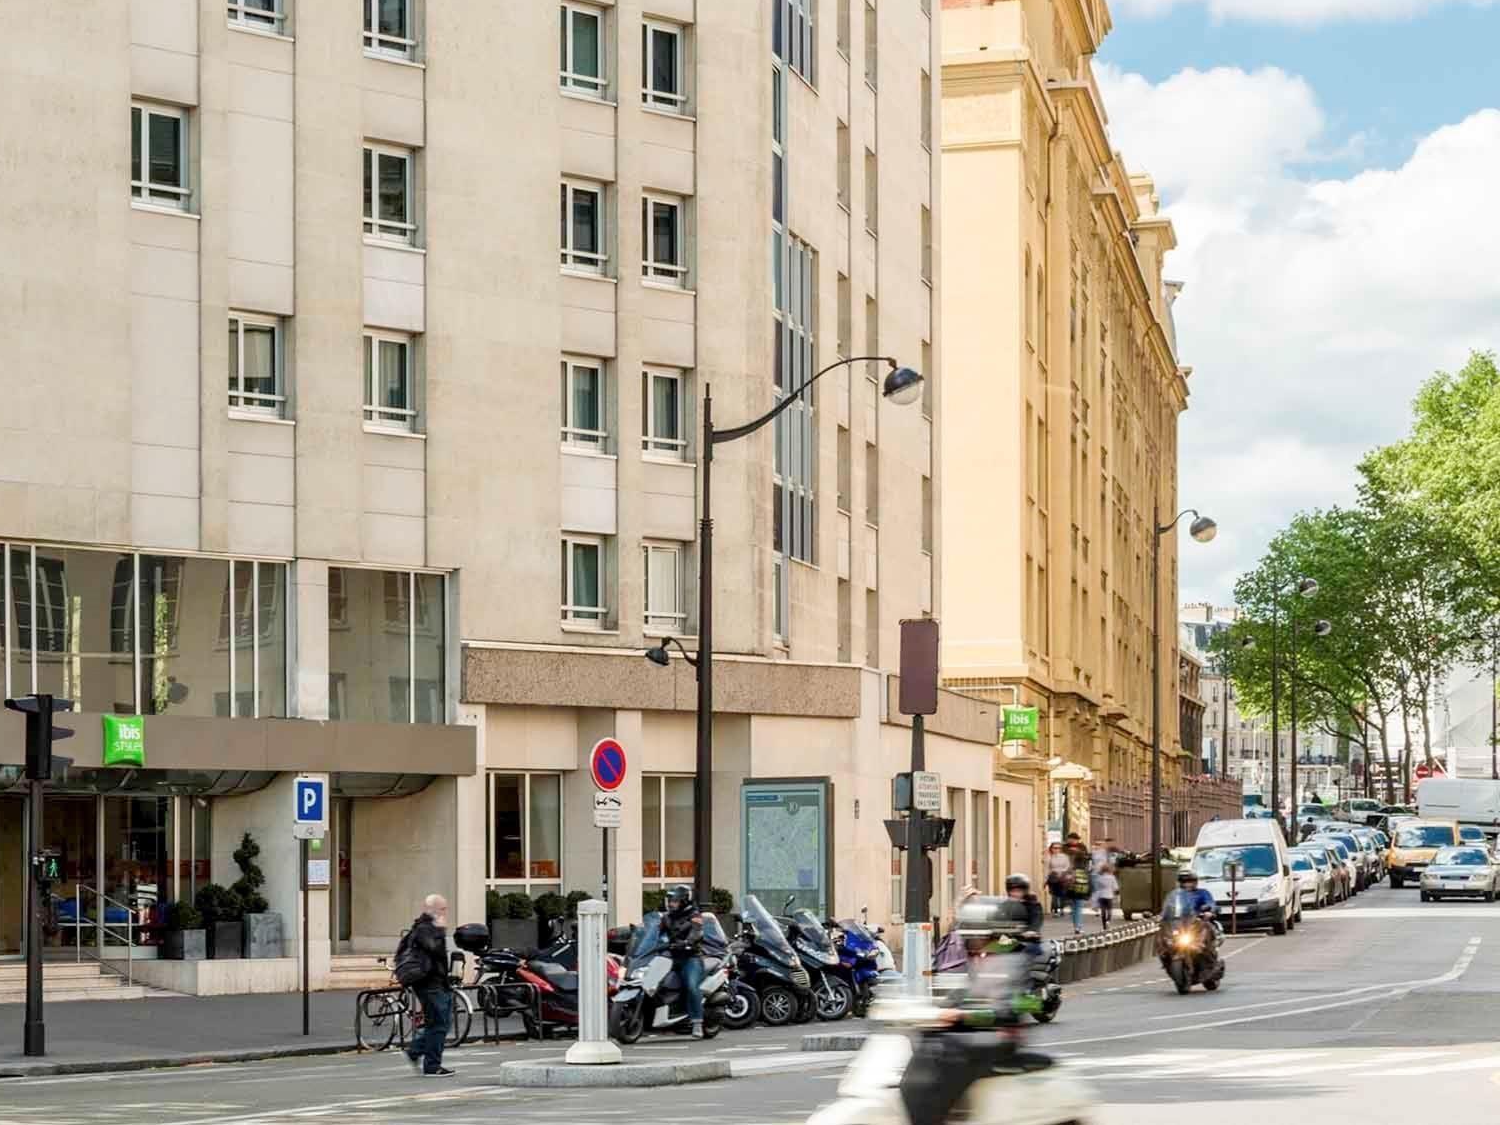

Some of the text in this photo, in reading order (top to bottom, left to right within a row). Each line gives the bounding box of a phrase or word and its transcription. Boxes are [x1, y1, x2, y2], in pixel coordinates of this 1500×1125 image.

[1010, 712, 1029, 725] ibis
[119, 723, 141, 740] ibis
[304, 788, 316, 814] P
